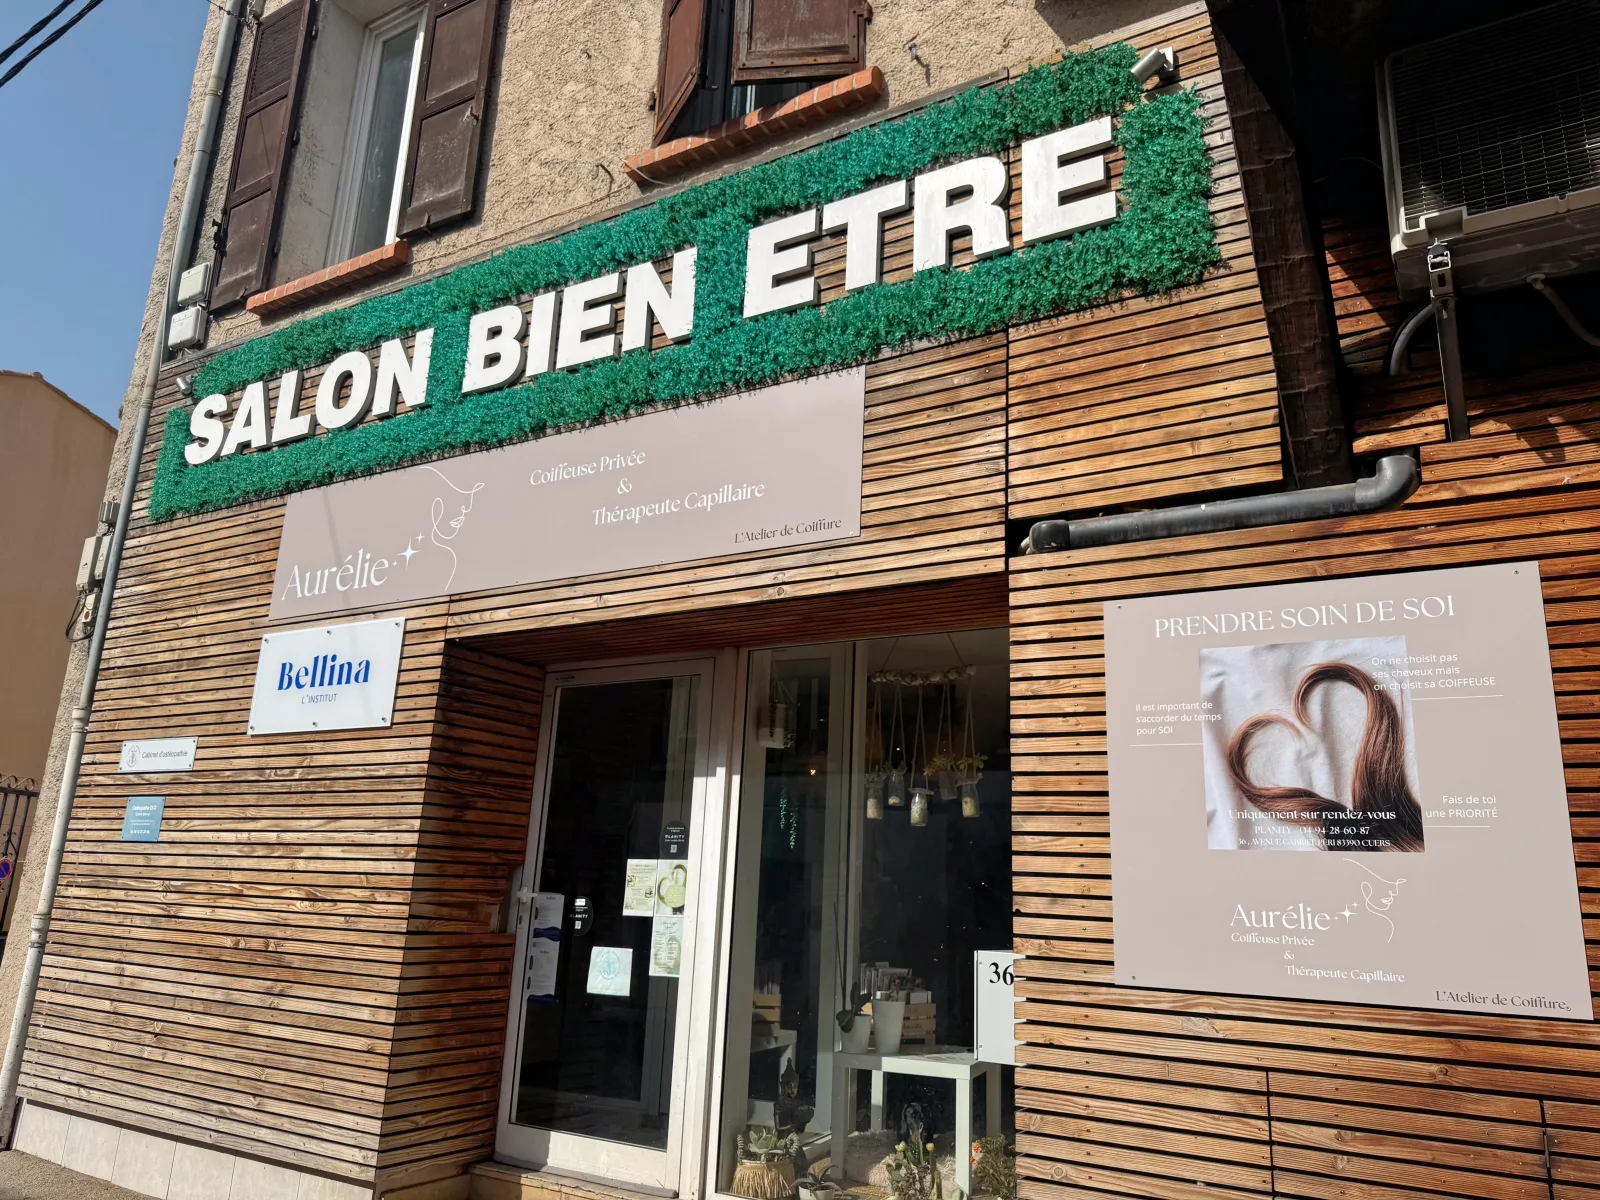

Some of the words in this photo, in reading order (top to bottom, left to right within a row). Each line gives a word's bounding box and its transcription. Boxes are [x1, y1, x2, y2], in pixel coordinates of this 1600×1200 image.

[184, 327, 434, 465] SALON
[461, 247, 697, 393] BIEN
[743, 116, 1117, 319] ETRE
[530, 462, 597, 485] Coiffeuse
[600, 450, 646, 472] Privée
[617, 478, 632, 494] &
[592, 498, 680, 525] Thérapeute
[684, 483, 765, 511] Capillaire
[734, 528, 778, 544] L'Atelier
[780, 525, 794, 537] de
[796, 519, 842, 534] Coiffure
[281, 548, 389, 600] Aurélie
[1155, 610, 1274, 637] PRENDRE
[1280, 603, 1348, 629] SOIN
[1355, 600, 1396, 623] DE
[1403, 595, 1455, 620] SOI
[1371, 657, 1386, 666] On
[1389, 657, 1401, 665] ne
[1403, 654, 1437, 664] choisit
[1440, 654, 1458, 664] pas
[277, 654, 370, 690] Bellina
[1372, 670, 1389, 679] ses
[1391, 668, 1433, 677] cheveux
[1435, 666, 1460, 675] mais
[1373, 683, 1386, 691] on
[1389, 680, 1422, 690] choisit
[1424, 681, 1436, 689] sa
[1438, 677, 1496, 688] COIFFEUSE
[1157, 702, 1199, 712] important
[1201, 701, 1213, 709] de
[1136, 714, 1178, 723] s'accorder
[1194, 714, 1221, 723] temps
[1136, 727, 1156, 736] pour
[1158, 726, 1173, 734] SOI
[1442, 795, 1463, 804] Fais
[1465, 795, 1479, 804] de
[1482, 795, 1496, 804] toi
[1229, 809, 1300, 824] Uniquement
[1301, 810, 1319, 819] sur
[1322, 809, 1396, 820] rendez-vous
[1425, 810, 1446, 818] une
[1448, 807, 1498, 818] PRIORITÉ
[1254, 826, 1291, 834] PLANITY
[1250, 838, 1282, 846] AVENUE
[1361, 839, 1391, 847] CUERS
[1230, 903, 1331, 931] Aurélie
[1231, 932, 1280, 944] Coiffeuse
[1282, 934, 1315, 946] Privée
[1284, 950, 1295, 960] &
[989, 962, 1014, 985] 36
[1284, 965, 1349, 980] Thérapeute
[1350, 969, 1405, 983] Capillaire
[1436, 990, 1488, 1004] L'Atelier
[1491, 993, 1508, 1005] de
[1510, 995, 1566, 1010] Coiffure
